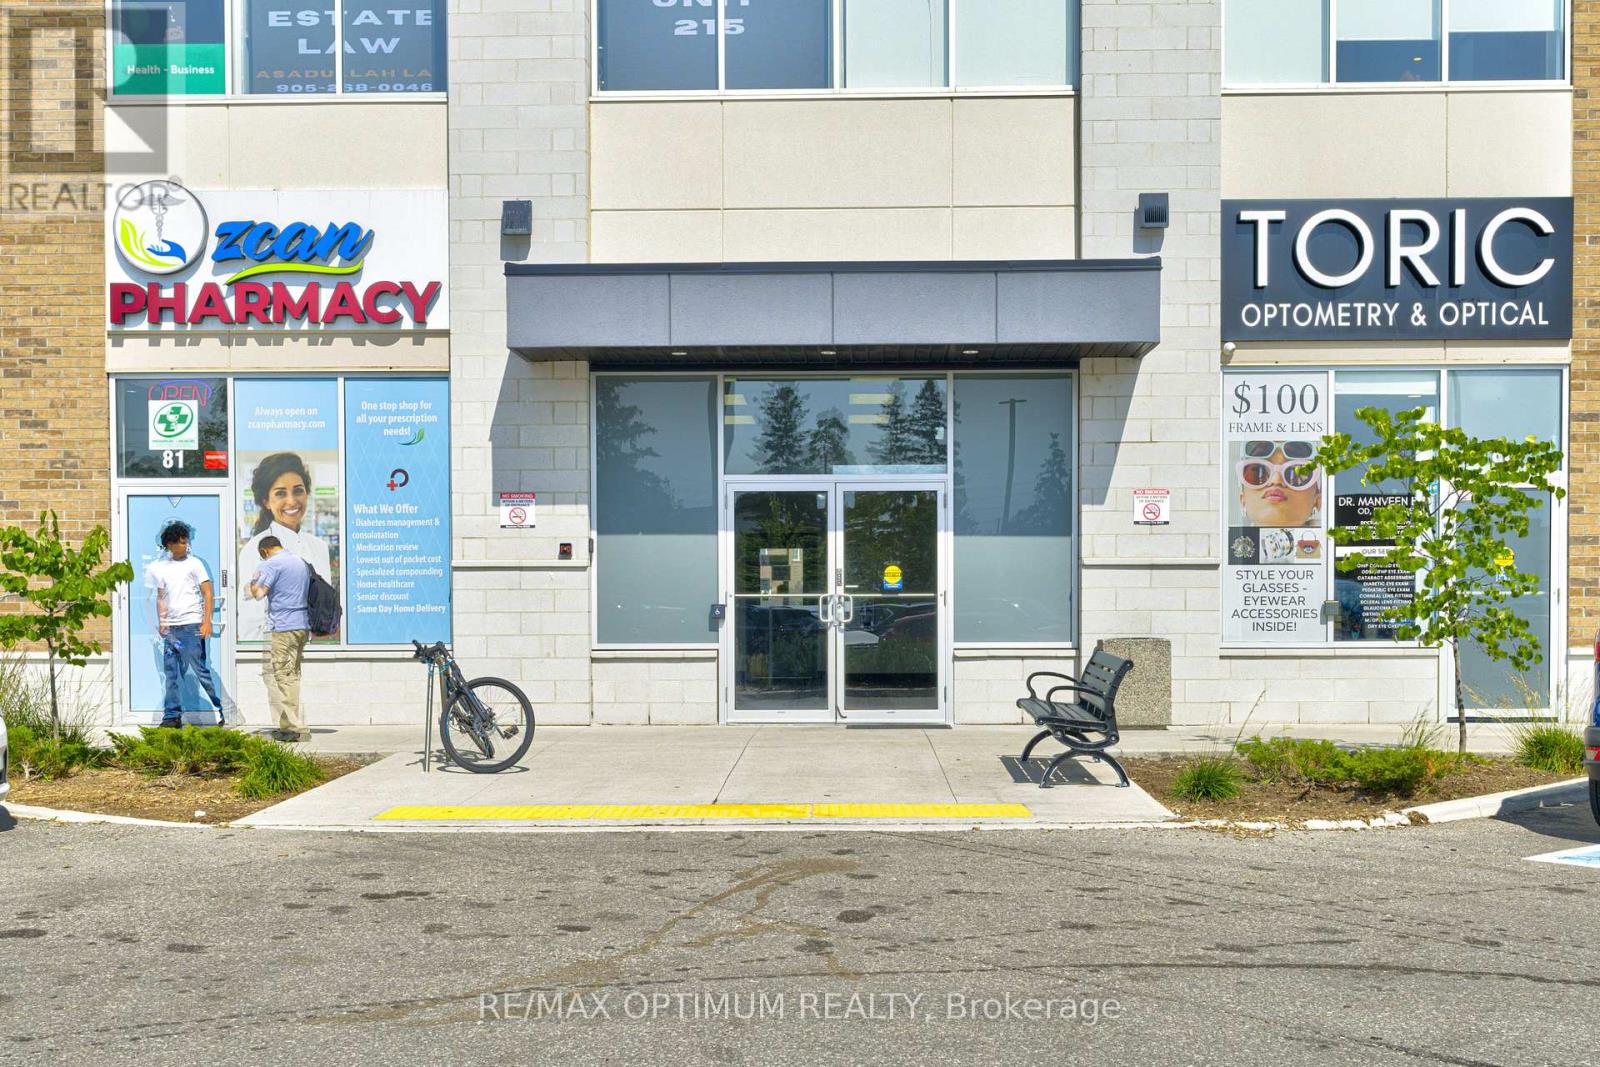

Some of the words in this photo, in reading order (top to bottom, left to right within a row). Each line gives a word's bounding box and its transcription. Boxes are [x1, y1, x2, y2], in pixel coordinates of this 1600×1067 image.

[268, 10, 432, 27] ESTATE
[673, 18, 745, 35] 215
[298, 37, 400, 54] LAW
[127, 64, 160, 74] Health
[170, 64, 214, 74] Business
[256, 69, 395, 78] ASADULAH
[1238, 207, 1555, 288] TORIC
[109, 280, 442, 325] PHARMACY
[1241, 301, 1399, 327] OPTOMETRY
[1410, 302, 1427, 326] &
[1439, 301, 1549, 326] OPTICAL
[148, 383, 208, 408] OPEN
[1232, 380, 1319, 418] $100
[362, 401, 378, 410] One
[380, 402, 398, 412] stop
[398, 400, 418, 412] shop
[419, 400, 432, 410] for
[255, 407, 283, 416] Always
[285, 408, 305, 417] open
[356, 414, 367, 423] all
[368, 416, 387, 424] your
[388, 414, 438, 424] prescription
[384, 426, 411, 436] needs!
[1229, 422, 1273, 433] FRAME
[1276, 422, 1287, 433] &
[1291, 422, 1323, 433] LENS
[162, 450, 184, 468] 81
[1338, 497, 1355, 506] DR.
[353, 504, 377, 514] What
[380, 504, 394, 514] We
[396, 504, 418, 514] Offer
[386, 519, 432, 528] management
[404, 556, 426, 564] pocket
[356, 568, 394, 576] Specialized
[396, 568, 443, 577] compounding
[1236, 570, 1275, 580] STYLE
[1279, 570, 1314, 580] YOUR
[378, 580, 414, 588] healthcare
[1242, 583, 1299, 592] GLASSES
[380, 592, 409, 600] discount
[1244, 596, 1306, 606] EYEWEAR
[378, 605, 393, 614] Day
[416, 604, 446, 614] Delivery
[1232, 609, 1318, 619] ACCESSORIES
[1252, 622, 1297, 632] INSIDE!
